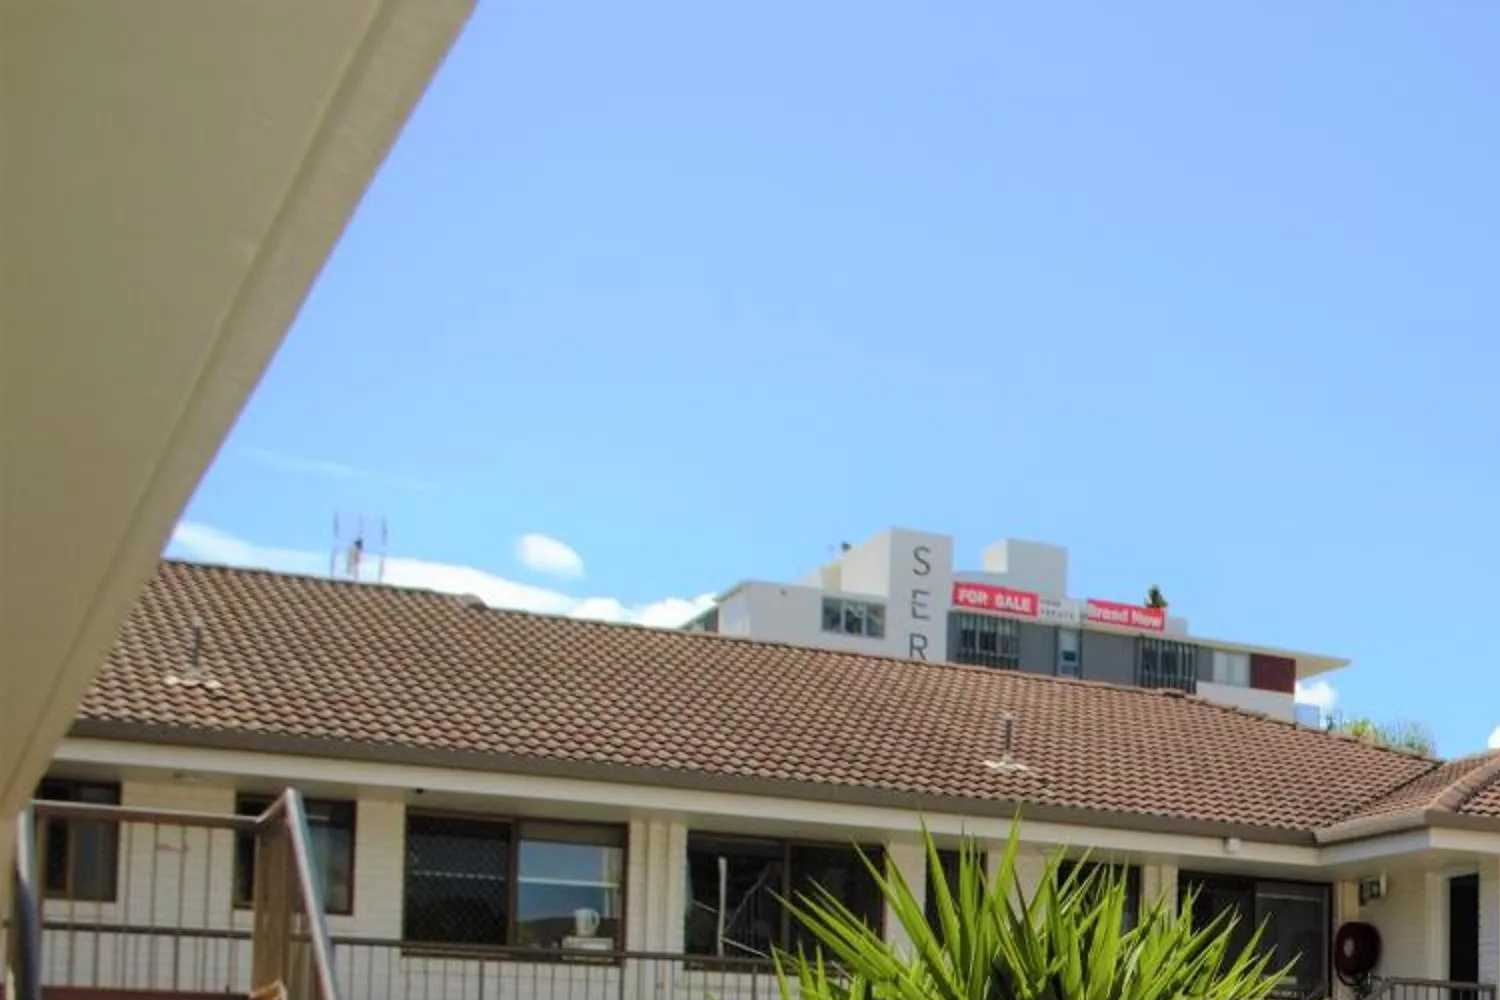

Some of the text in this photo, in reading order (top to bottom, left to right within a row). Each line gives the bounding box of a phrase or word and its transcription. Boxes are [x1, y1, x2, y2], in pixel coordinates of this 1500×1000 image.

[909, 545, 931, 660] SER
[957, 587, 1031, 612] FOR SALE
